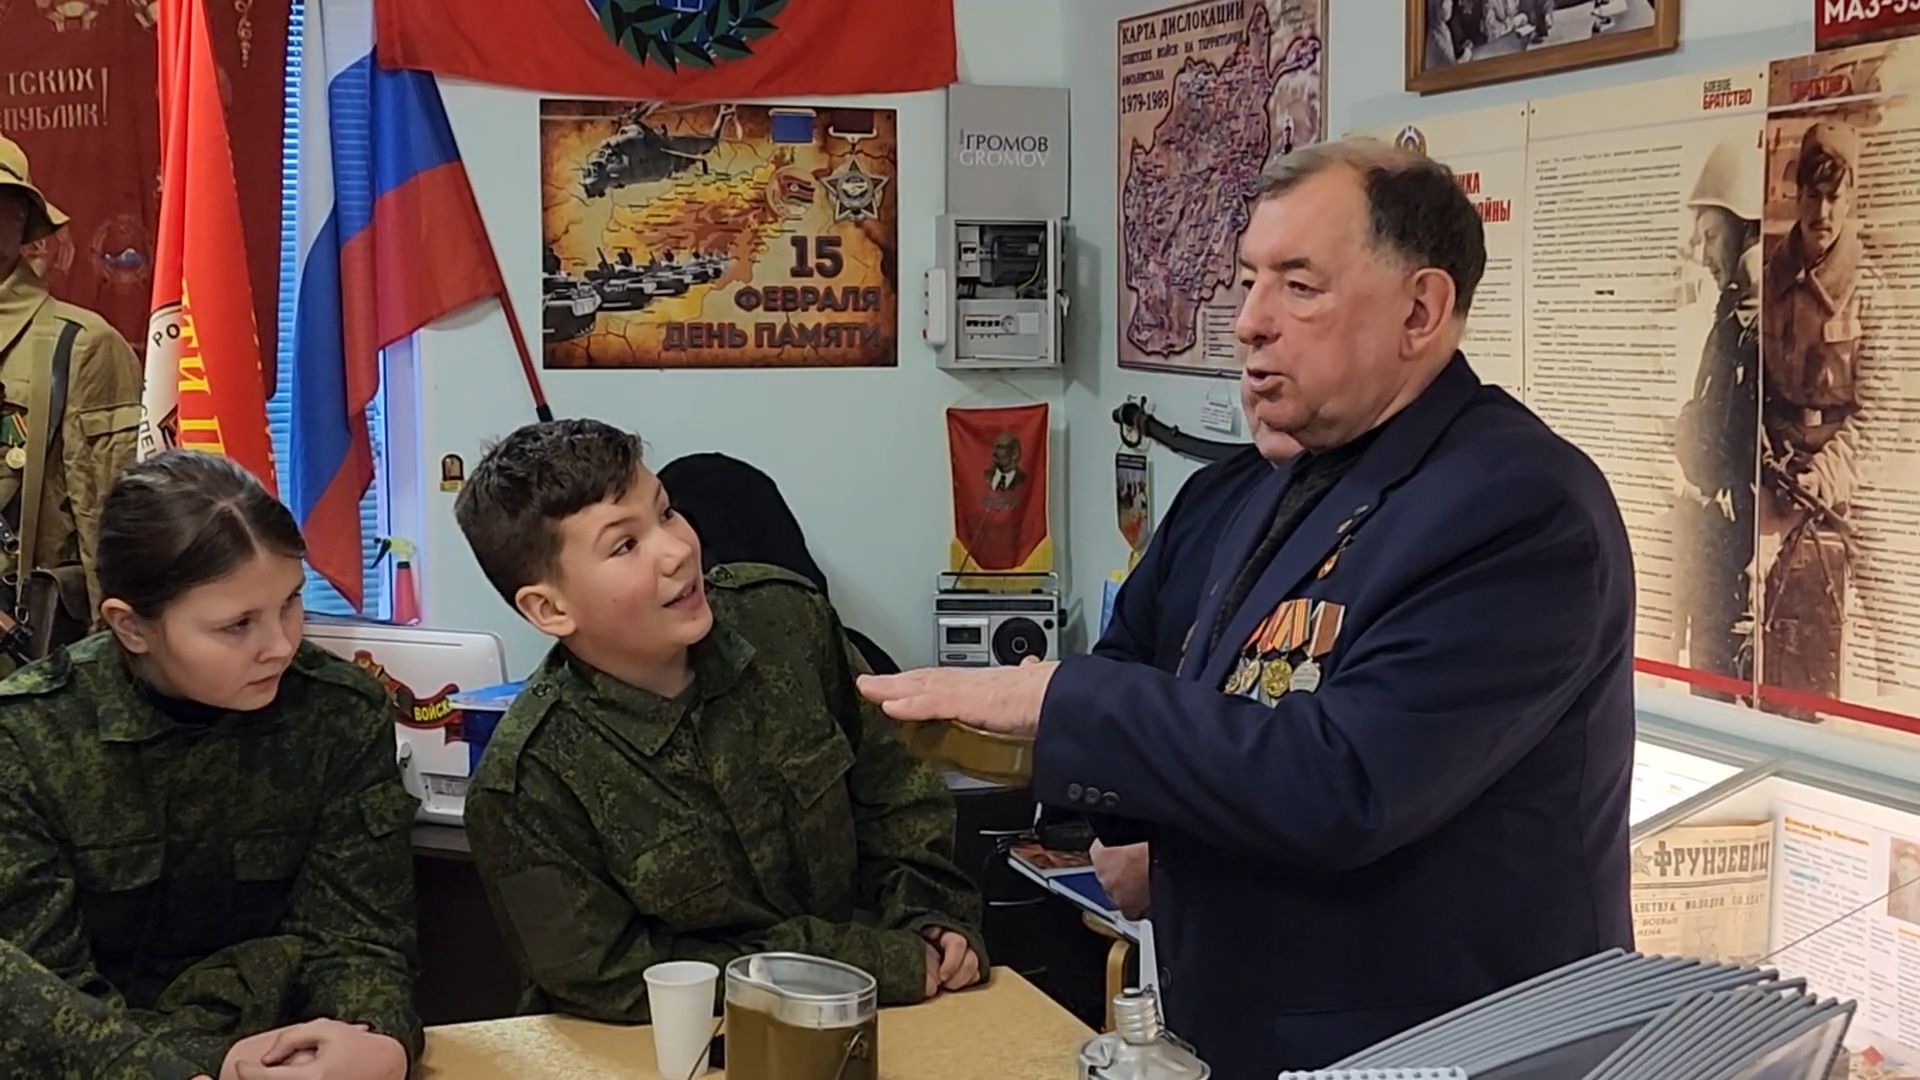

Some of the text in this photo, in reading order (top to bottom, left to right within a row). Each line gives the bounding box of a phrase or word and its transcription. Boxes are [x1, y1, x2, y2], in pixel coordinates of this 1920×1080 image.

[1122, 1, 1244, 45] КАРТА ДИСЛОКАЦИИ
[1121, 89, 1169, 114] 1979-1989
[1703, 88, 1752, 110] БРАТСТВО
[966, 132, 1049, 153] ГРОМОВ
[960, 149, 1051, 168] GROMOV
[790, 235, 844, 278] 15
[733, 286, 882, 312] ФЕВРАЛЯ
[662, 322, 882, 351] ДЕНЬ ПАМЯТИ
[1654, 841, 1770, 877] ФРУНЗЕВЕЦ
